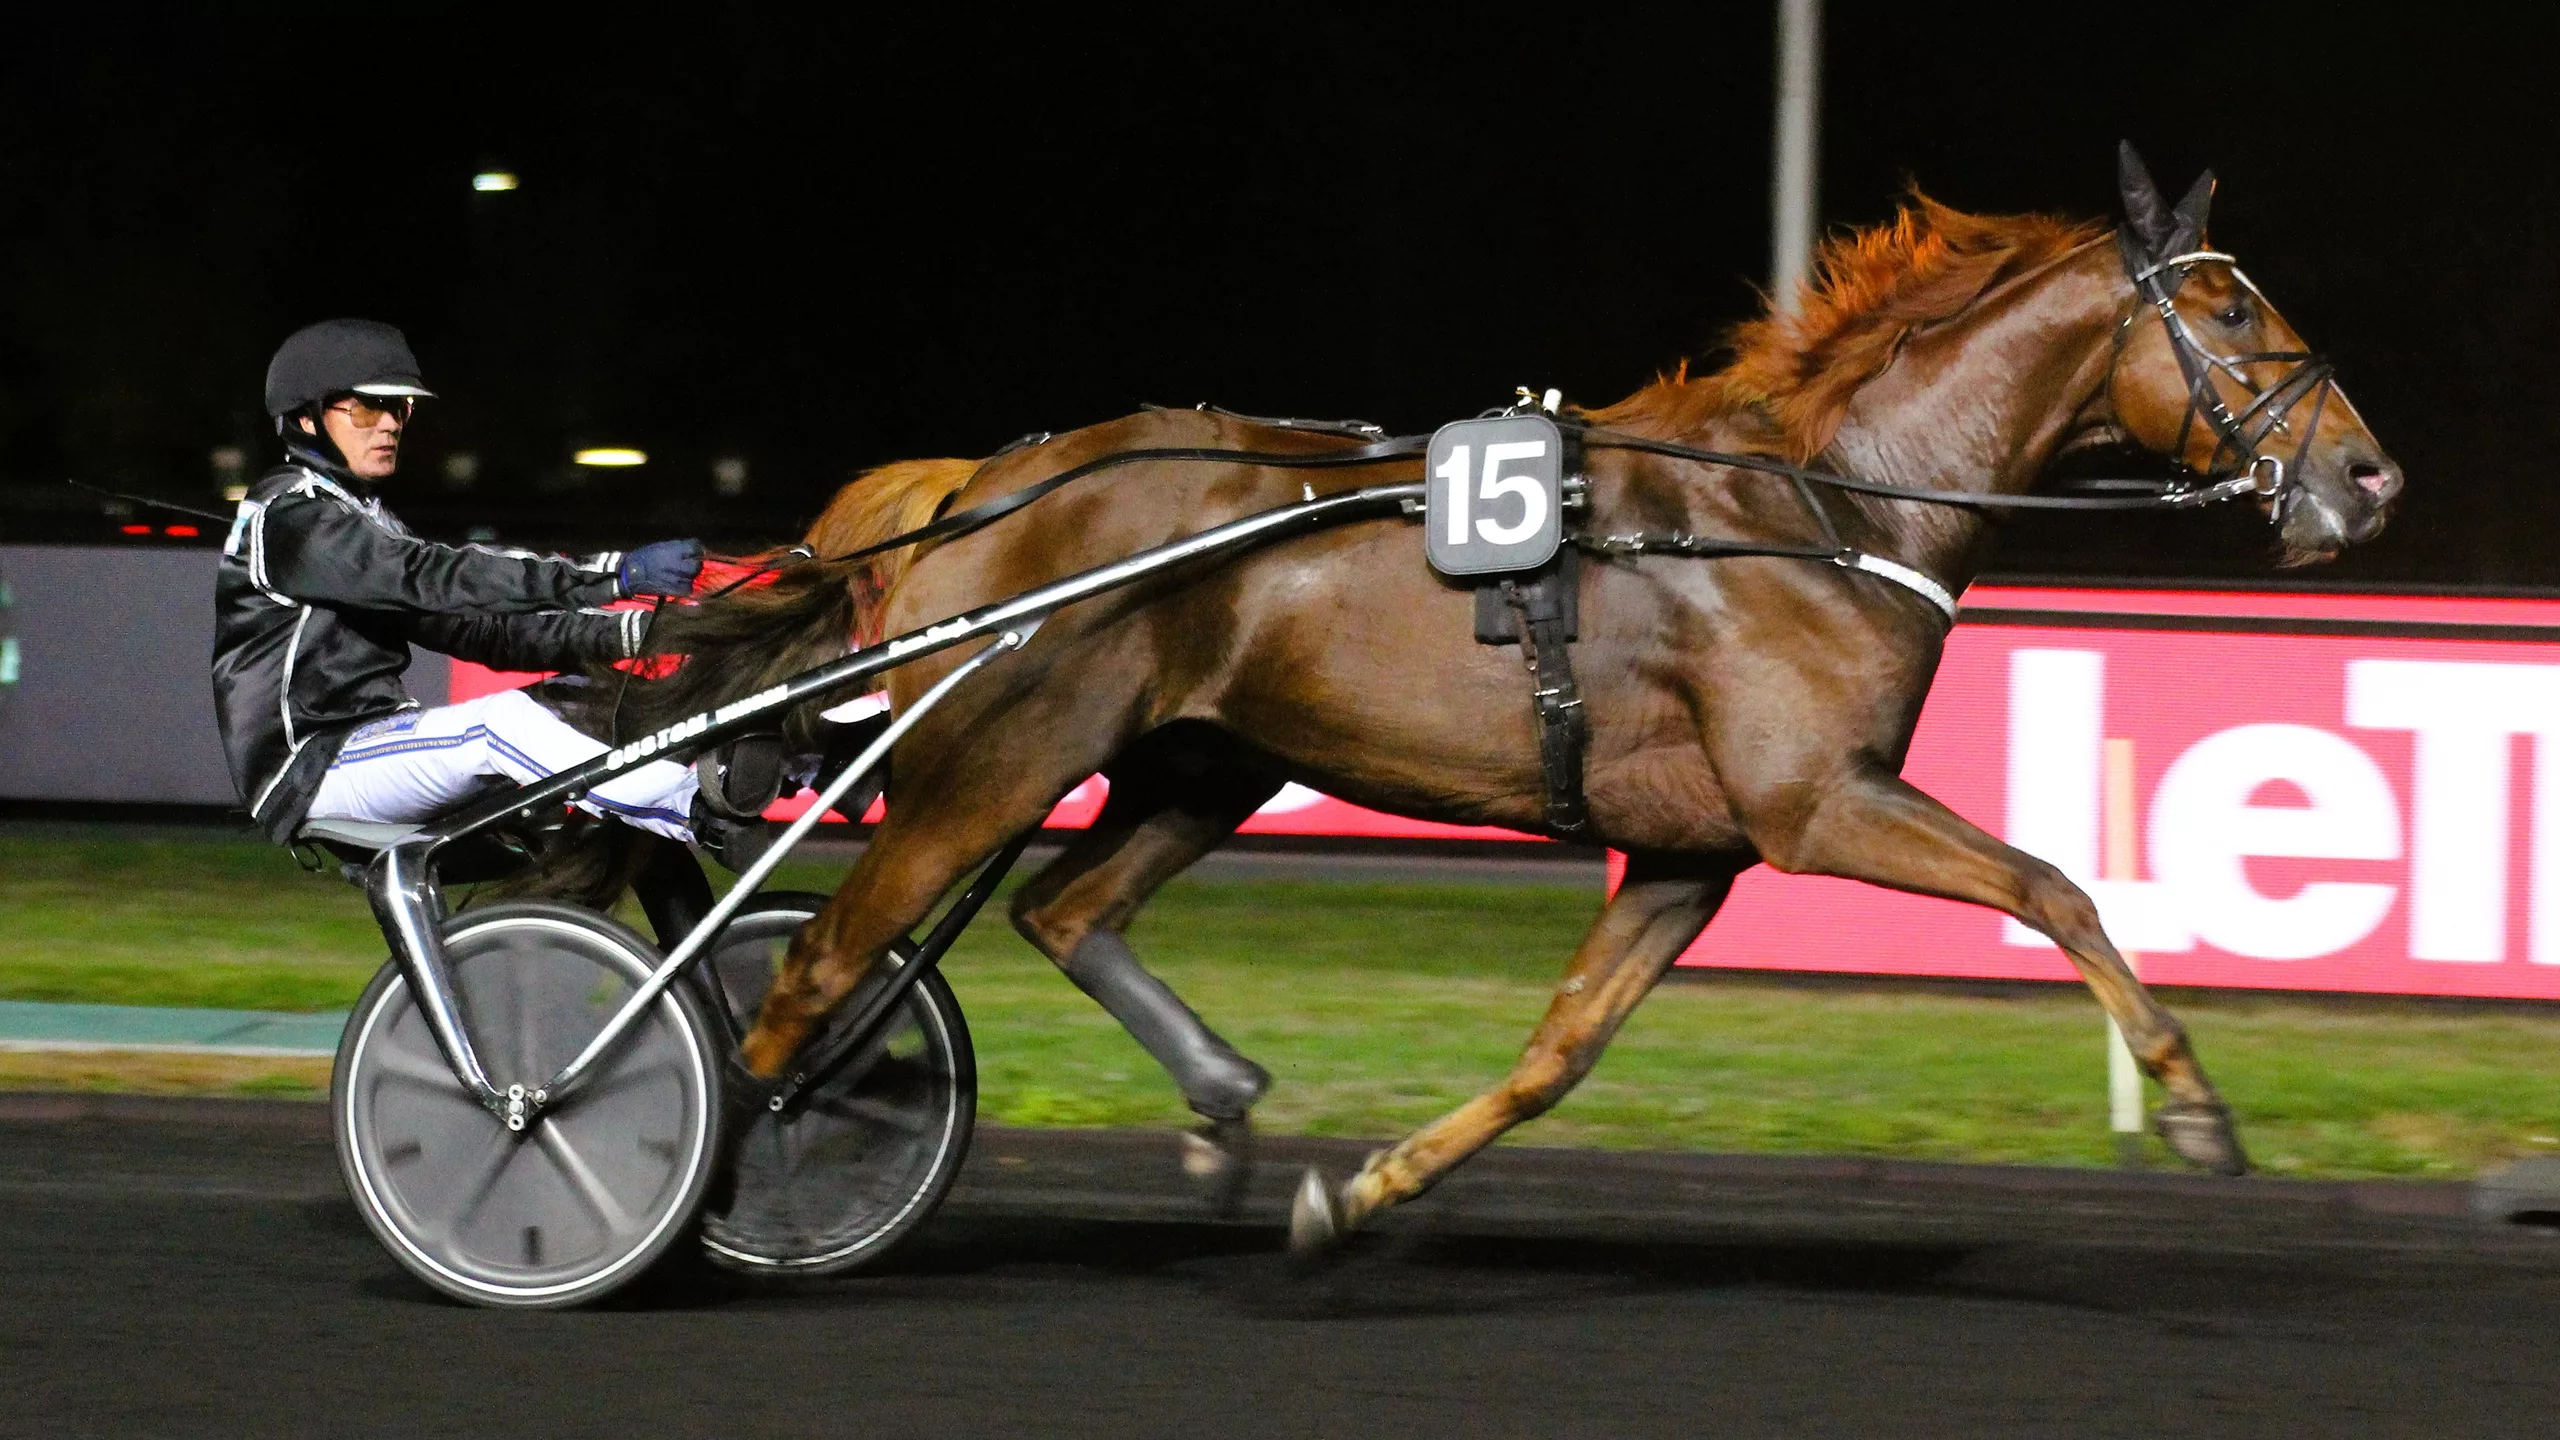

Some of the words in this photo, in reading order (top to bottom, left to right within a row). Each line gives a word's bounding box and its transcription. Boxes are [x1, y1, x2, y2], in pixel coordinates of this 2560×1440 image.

[1435, 440, 1548, 545] 15
[606, 712, 708, 771] CUSTOM
[2004, 648, 2560, 966] LeT
